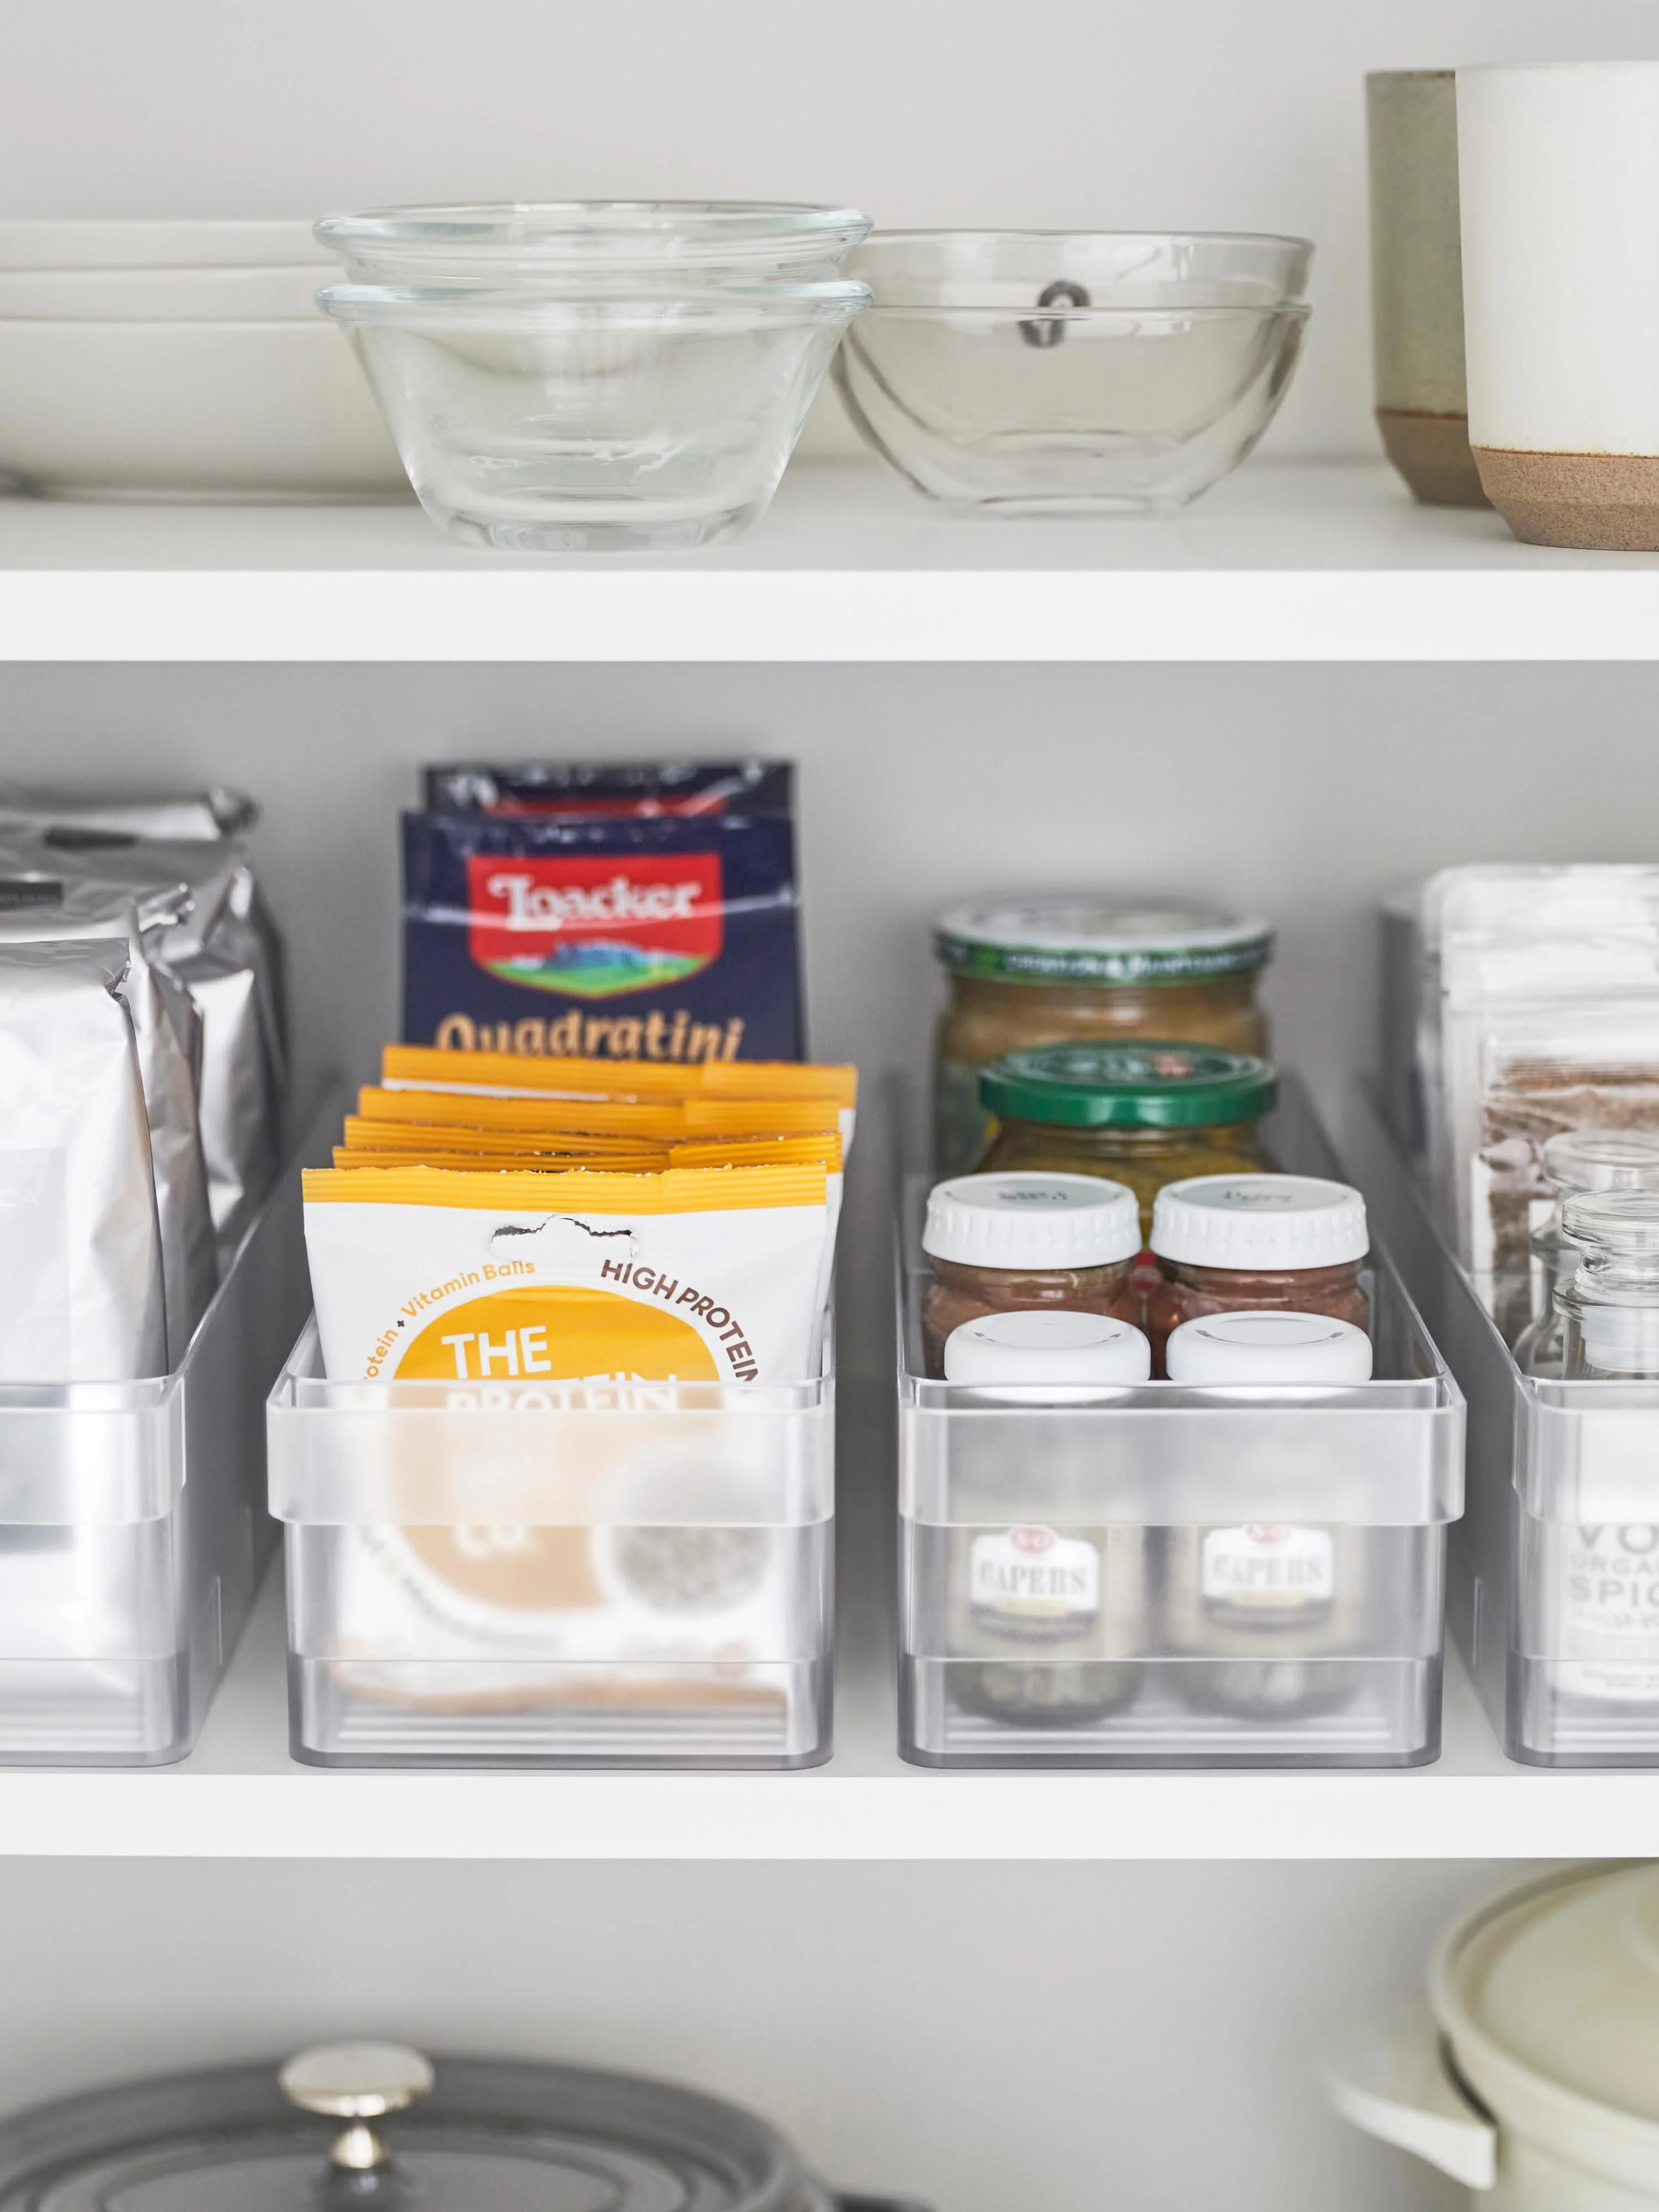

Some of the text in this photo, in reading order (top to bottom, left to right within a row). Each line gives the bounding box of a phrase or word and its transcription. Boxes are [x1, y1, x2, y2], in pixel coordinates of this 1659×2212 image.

[487, 874, 701, 932] Loacker
[400, 1271, 480, 1317] Vitamin
[482, 1261, 535, 1280] Balls
[601, 1259, 679, 1300] HIGH
[441, 1325, 552, 1379] THE
[978, 1559, 1087, 1596] CAPERS
[1569, 1551, 1659, 1576] ORGA
